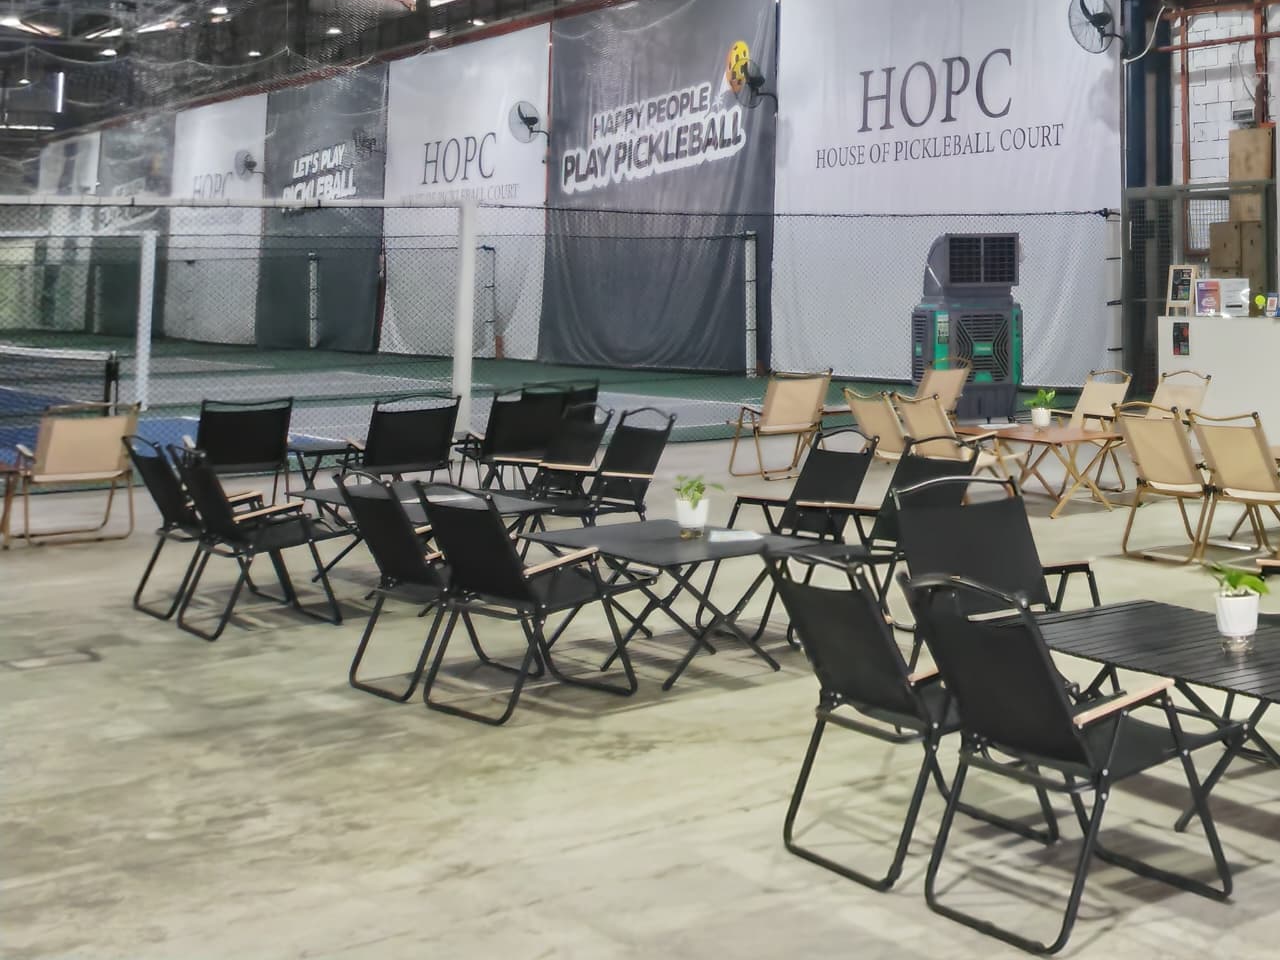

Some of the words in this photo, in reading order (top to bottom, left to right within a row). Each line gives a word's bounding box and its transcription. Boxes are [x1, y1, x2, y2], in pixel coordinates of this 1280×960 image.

[592, 103, 643, 139] HAPPY
[647, 86, 710, 123] PEOPLE
[858, 48, 1012, 133] HOPC
[293, 151, 319, 179] LET'S
[320, 143, 346, 170] PLAY
[422, 132, 497, 185] HOPC
[563, 143, 612, 187] PLAY
[613, 110, 743, 173] PICKLEBALL
[816, 144, 866, 169] HOUSE
[869, 142, 891, 164] OF
[894, 131, 996, 162] PICKLEBALL
[999, 123, 1064, 152] COURT
[487, 183, 520, 201] COURT
